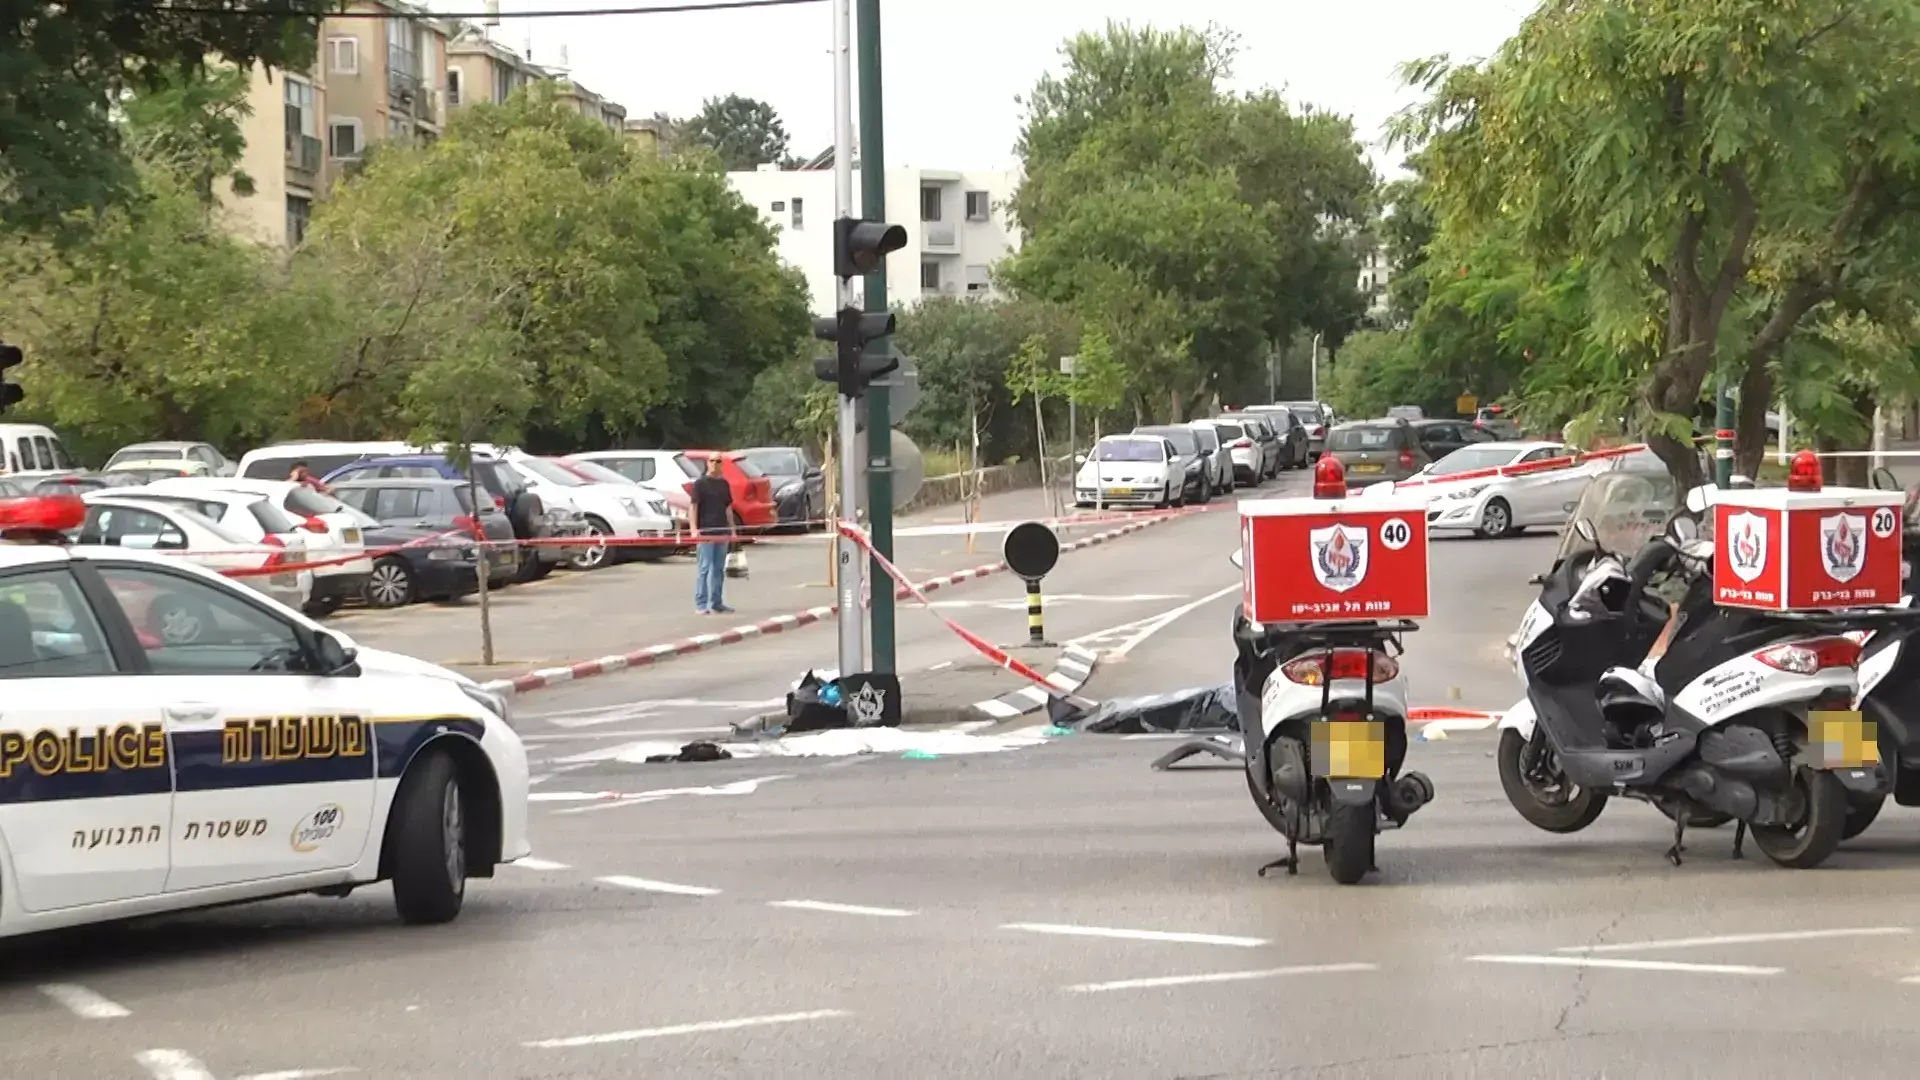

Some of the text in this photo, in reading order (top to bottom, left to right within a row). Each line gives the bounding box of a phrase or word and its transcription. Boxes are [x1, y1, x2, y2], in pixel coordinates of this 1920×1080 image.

[1874, 513, 1893, 532] 20
[1384, 523, 1407, 543] 40
[1343, 601, 1361, 613] תל
[223, 714, 366, 762] משטרה
[0, 723, 165, 777] POLICE
[312, 807, 338, 826] 100
[71, 817, 268, 851] משטרת התנועה
